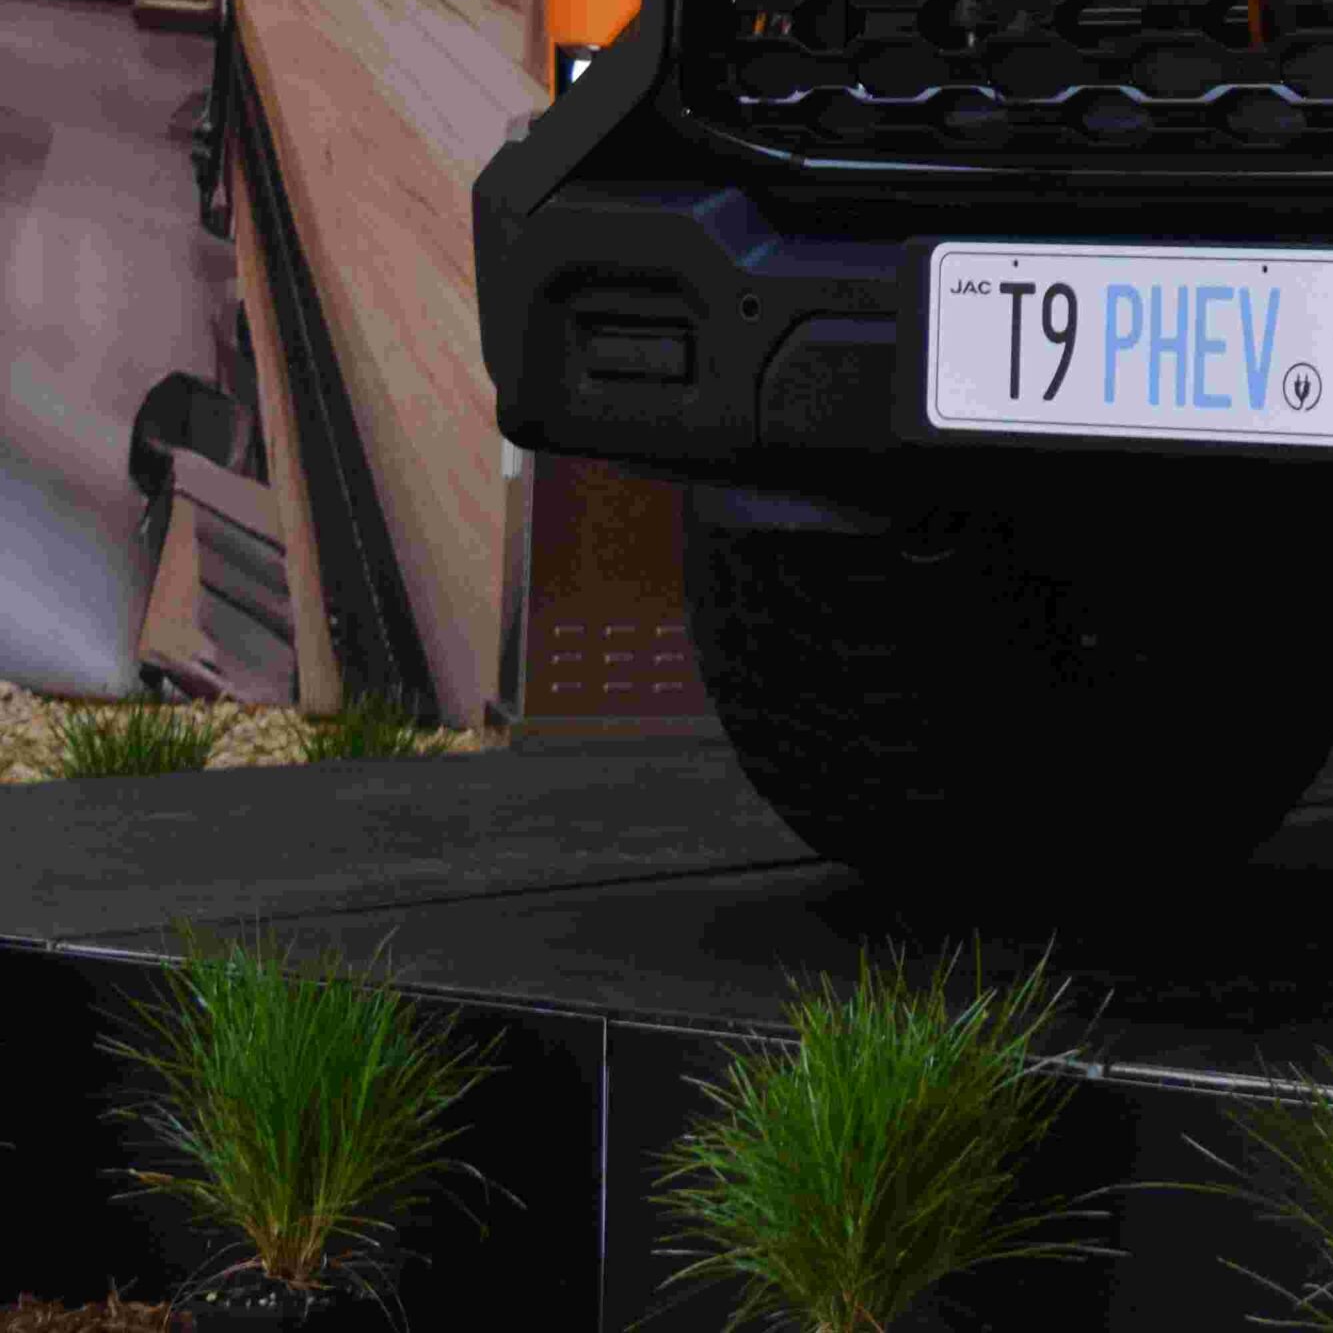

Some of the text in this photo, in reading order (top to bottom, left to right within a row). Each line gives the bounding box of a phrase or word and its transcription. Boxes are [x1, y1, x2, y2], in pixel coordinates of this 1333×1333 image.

[950, 279, 992, 295] JAC
[999, 282, 1281, 410] T9 PHEV
